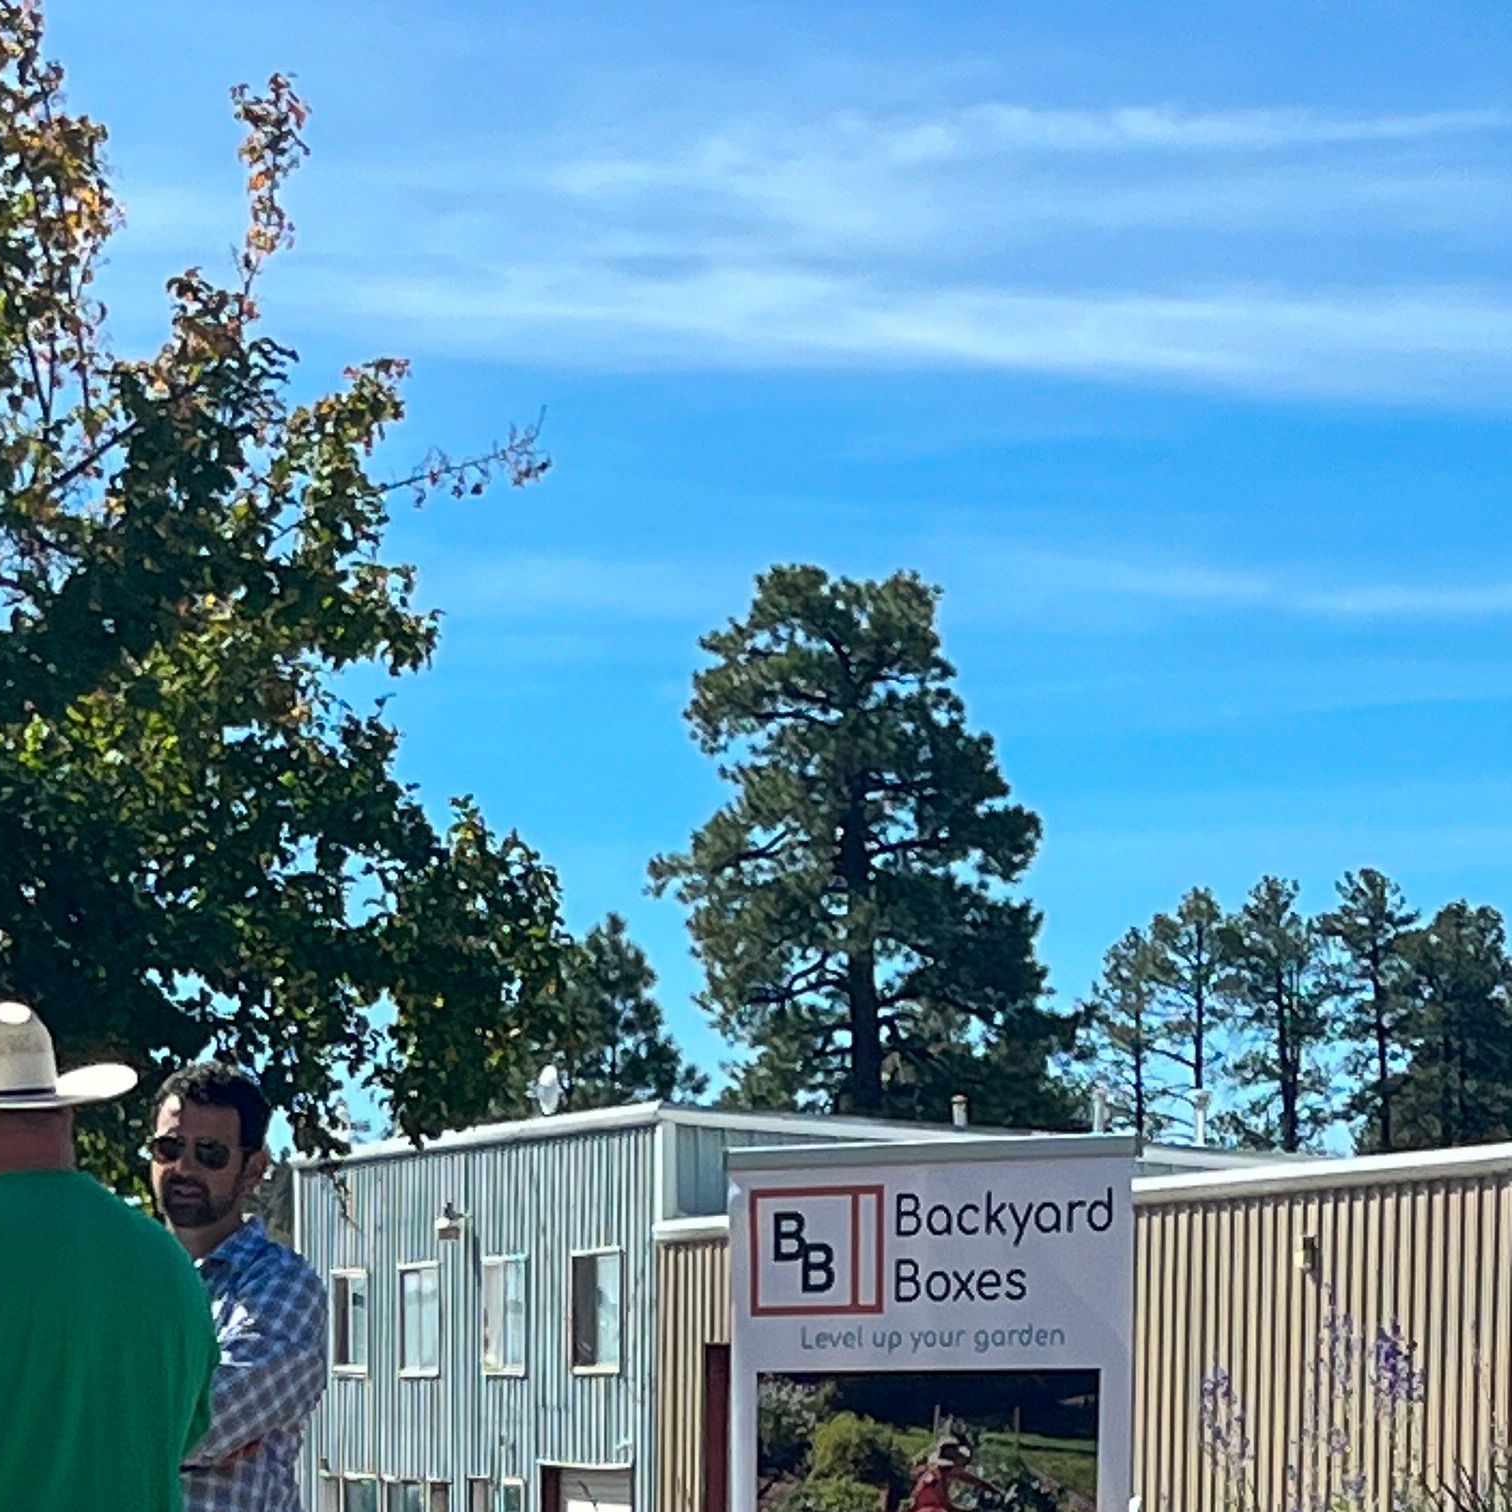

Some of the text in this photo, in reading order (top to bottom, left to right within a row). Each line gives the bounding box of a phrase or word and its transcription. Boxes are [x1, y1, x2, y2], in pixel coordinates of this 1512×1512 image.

[894, 1187, 1113, 1247] Backyard
[894, 1258, 1028, 1302] Boxes
[800, 1322, 1066, 1354] Level up your garden
